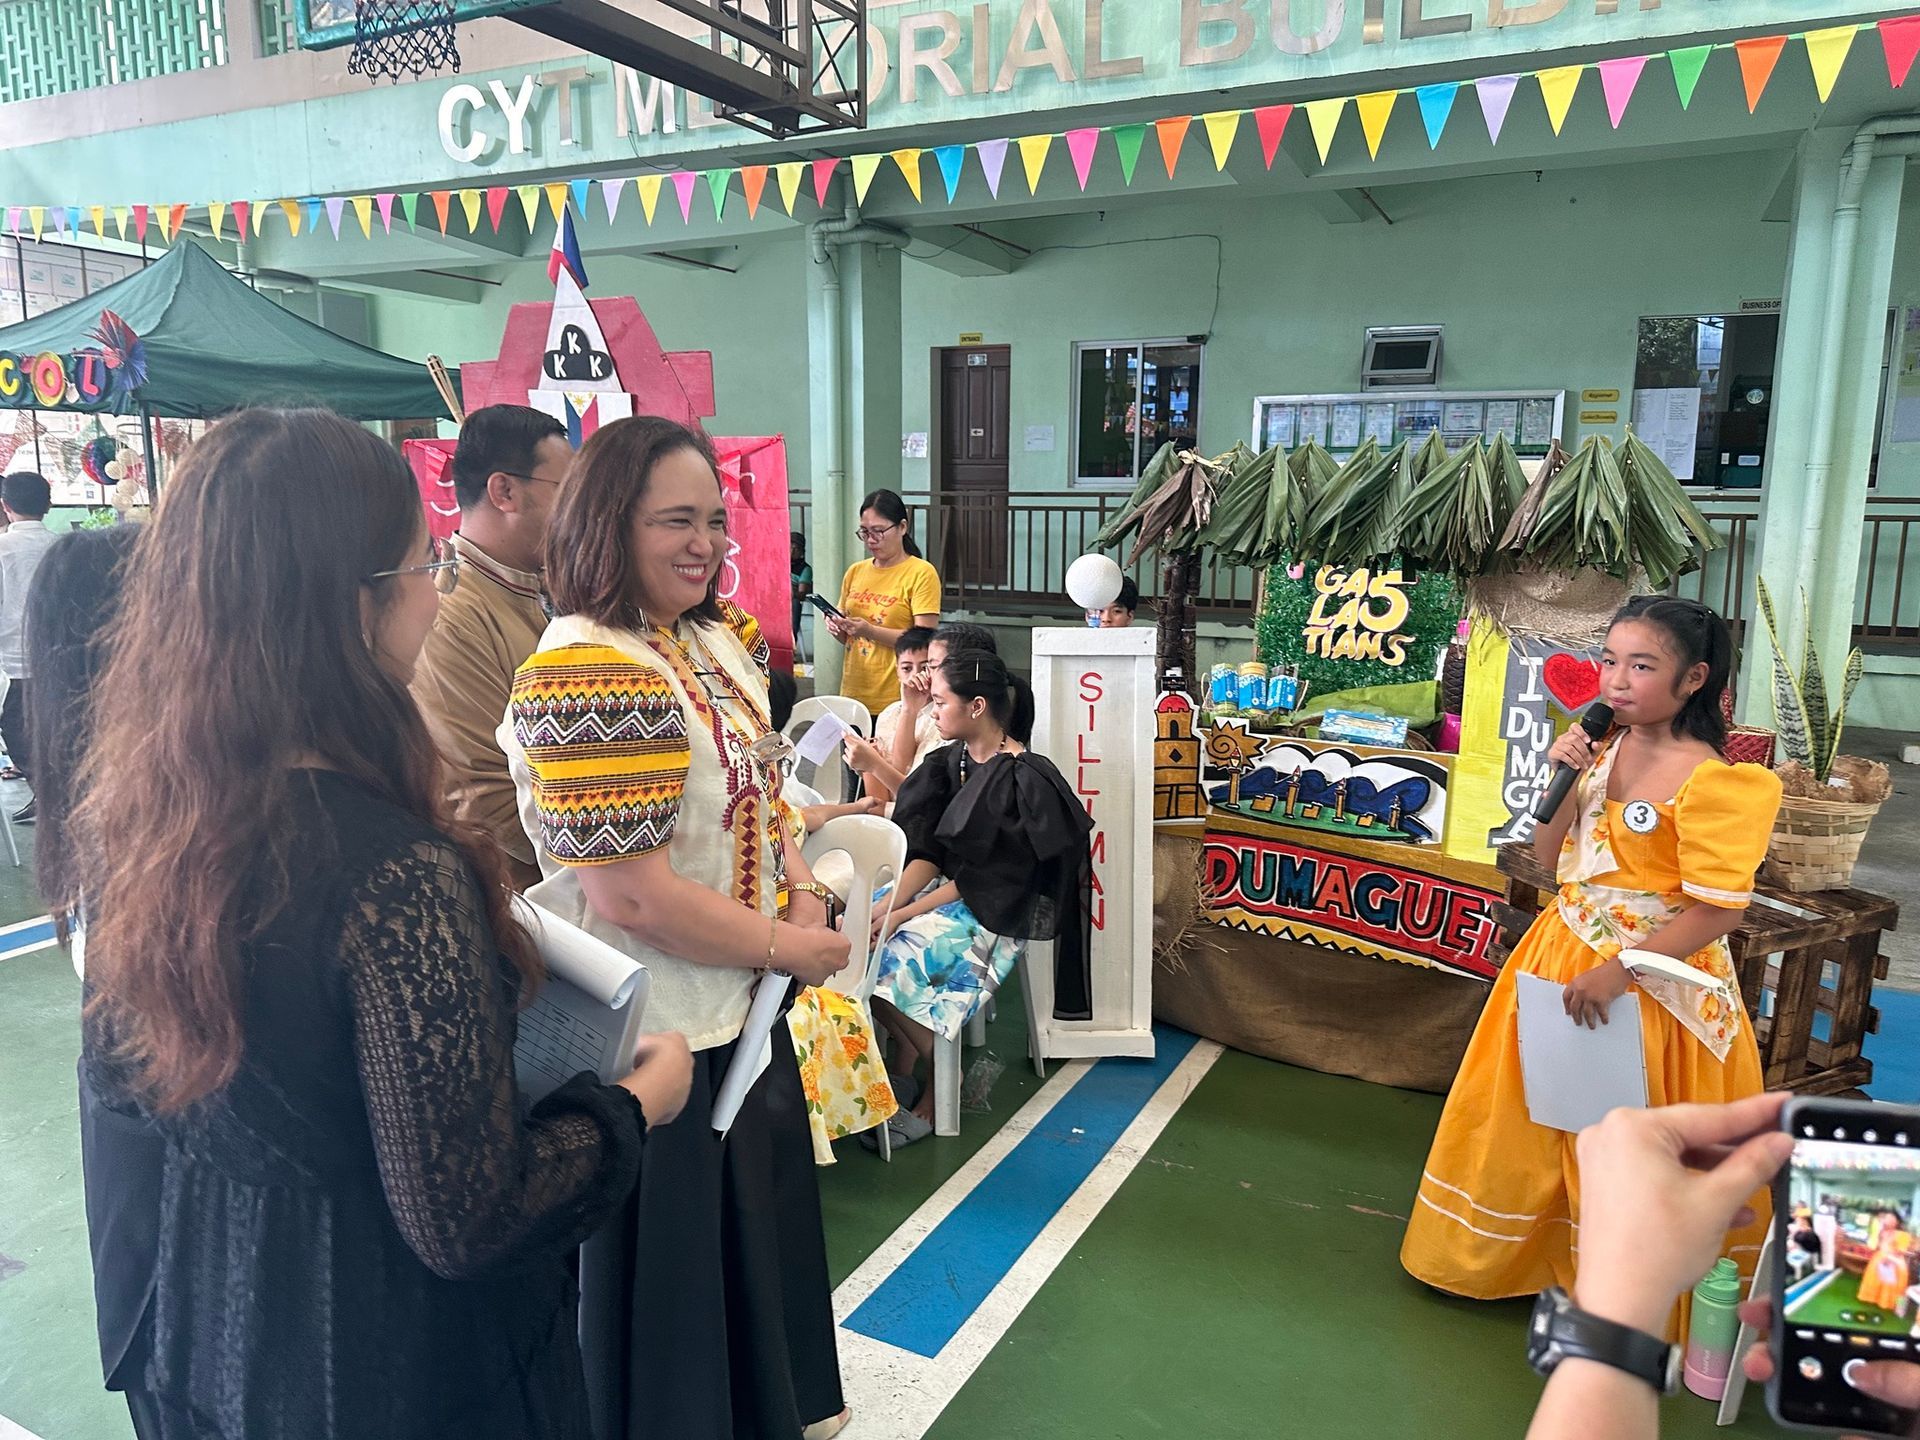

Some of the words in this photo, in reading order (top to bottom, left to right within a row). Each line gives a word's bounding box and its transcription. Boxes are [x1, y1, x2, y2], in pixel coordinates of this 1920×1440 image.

[437, 66, 588, 164] CYT
[1742, 301, 1771, 310] BUSINESS
[567, 331, 582, 355] K
[553, 353, 567, 379] K
[589, 354, 604, 378] K
[1306, 593, 1360, 630] LA
[1301, 627, 1417, 667] TIANS
[1517, 656, 1543, 702] I
[1633, 804, 1649, 825] 3
